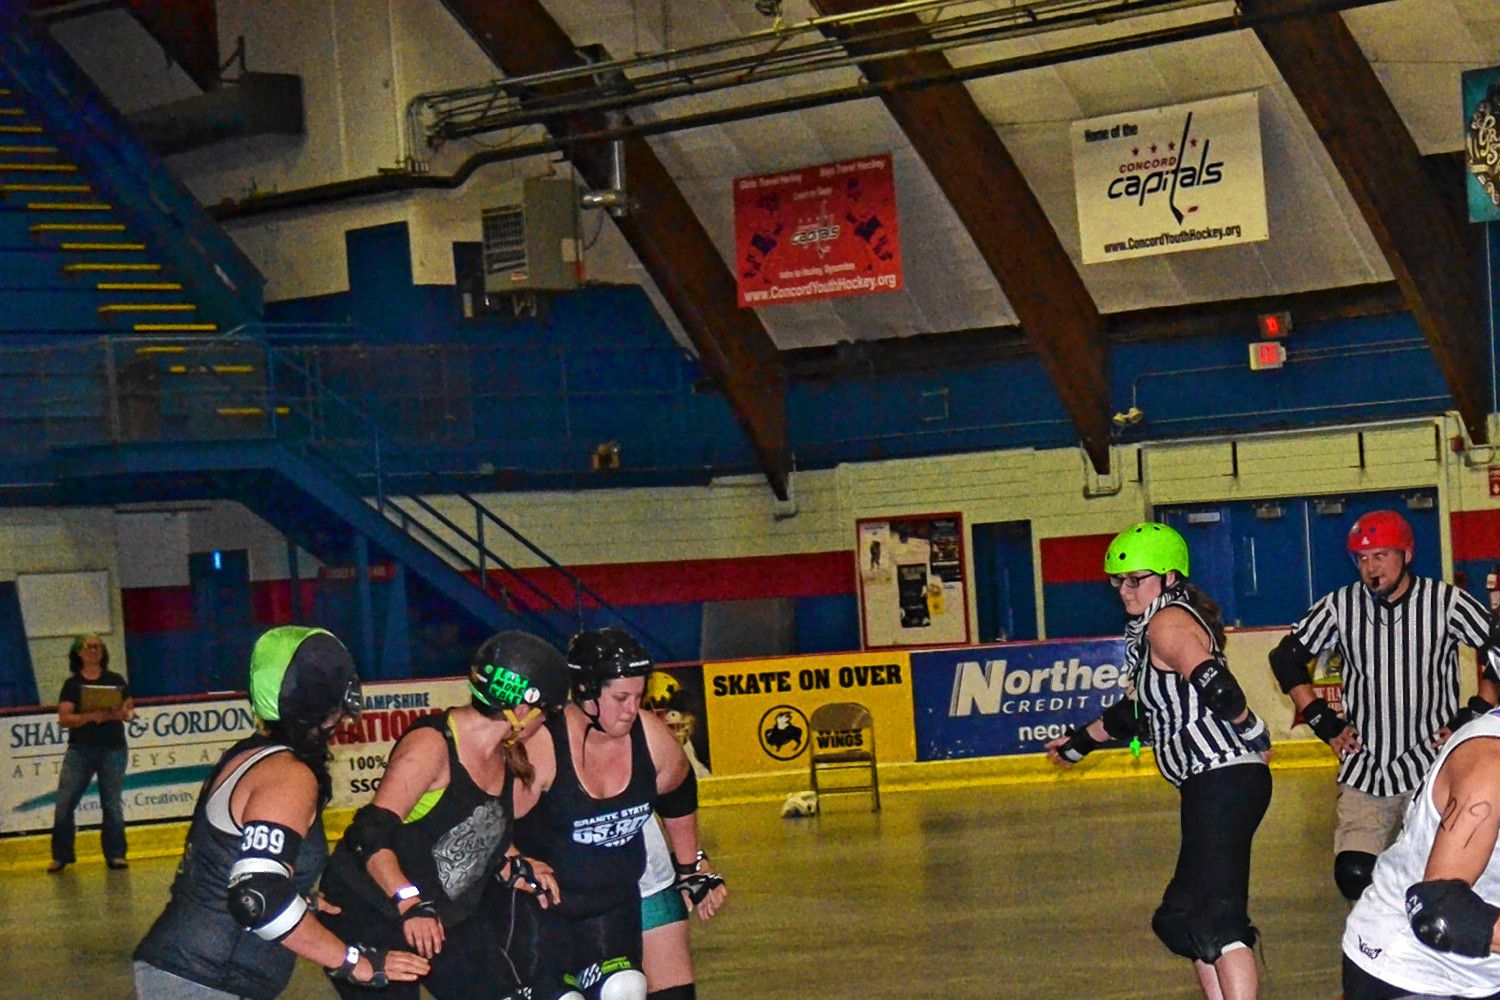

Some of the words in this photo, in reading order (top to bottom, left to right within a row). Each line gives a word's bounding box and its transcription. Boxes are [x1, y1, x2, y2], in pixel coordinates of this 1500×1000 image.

[1119, 156, 1176, 174] CONCORD
[1104, 224, 1242, 254] www.ConcordYouthHockey.org
[744, 273, 897, 302] www.ConcordYouthHockey.org
[713, 671, 791, 696] SKATE
[799, 668, 830, 690] ON
[838, 664, 902, 688] OVER
[364, 692, 430, 710] AMPSHIRE
[1002, 696, 1089, 715] CREDIT
[128, 715, 150, 739] &
[153, 707, 255, 738] GORDON
[816, 733, 863, 749] WINGS
[241, 825, 285, 855] 369
